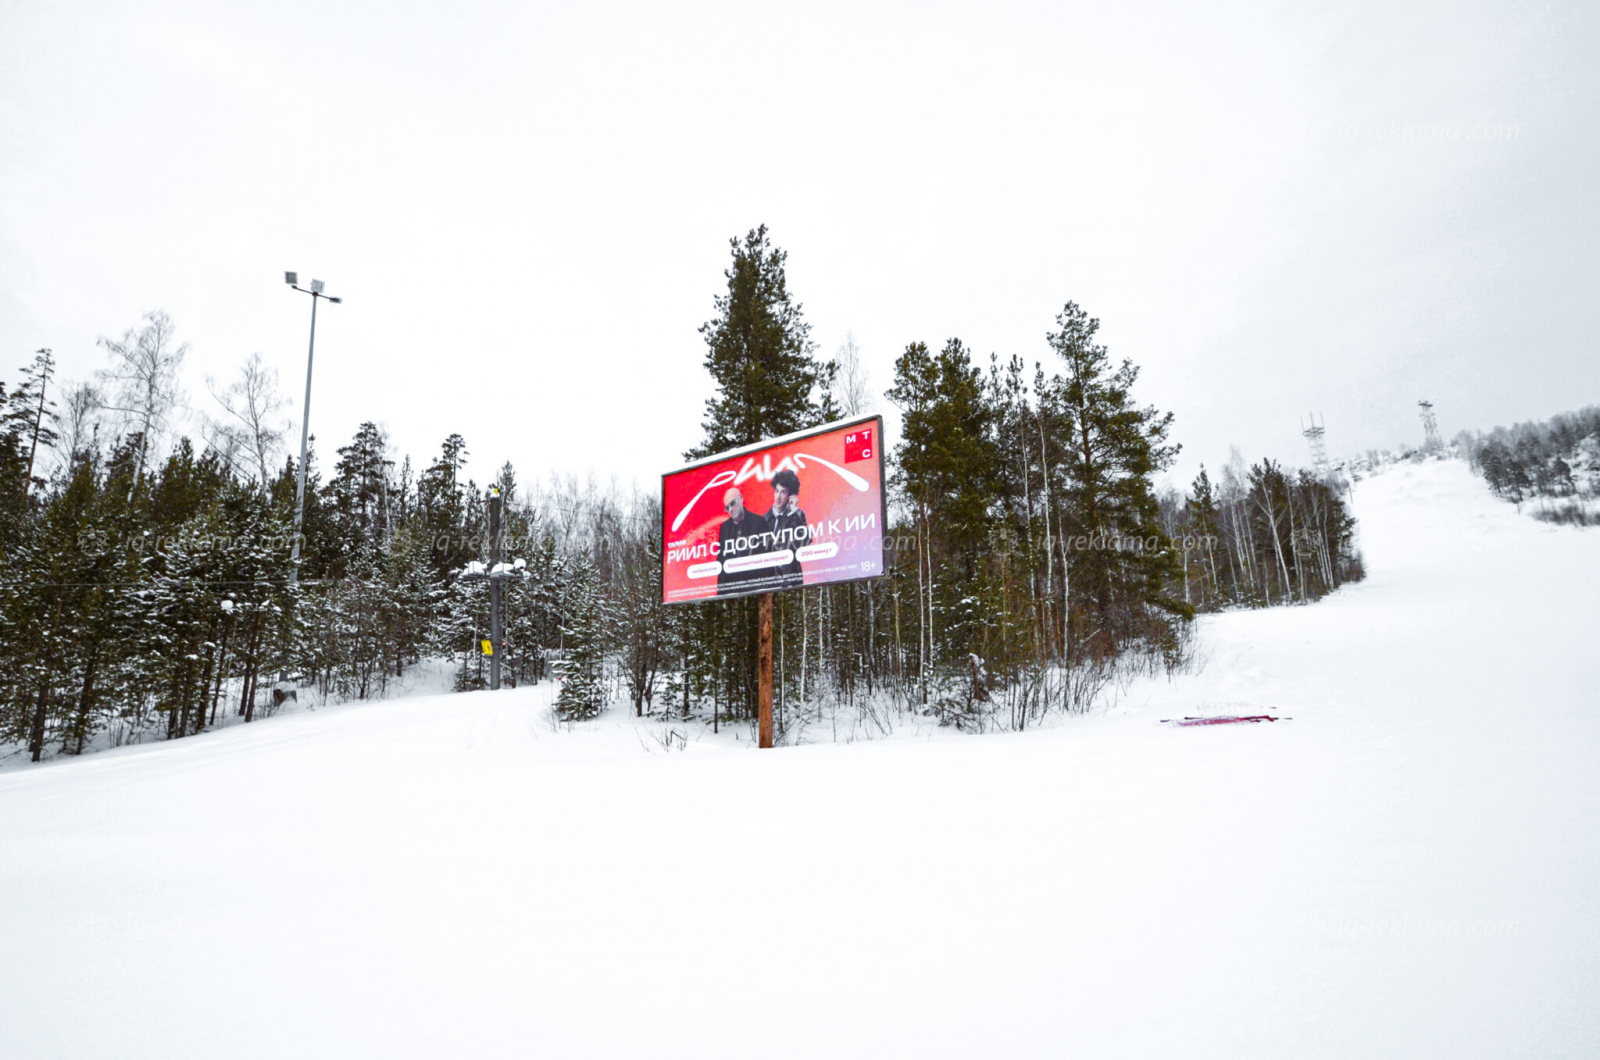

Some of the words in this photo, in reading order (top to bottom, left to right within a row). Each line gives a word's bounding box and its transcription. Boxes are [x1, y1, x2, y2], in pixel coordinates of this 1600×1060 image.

[667, 543, 707, 564] РИИЛ
[709, 542, 721, 556] С
[723, 522, 823, 556] ДОСТУПОМ
[828, 519, 841, 535] К
[845, 513, 876, 533] ИИ
[861, 561, 876, 572] 18+
